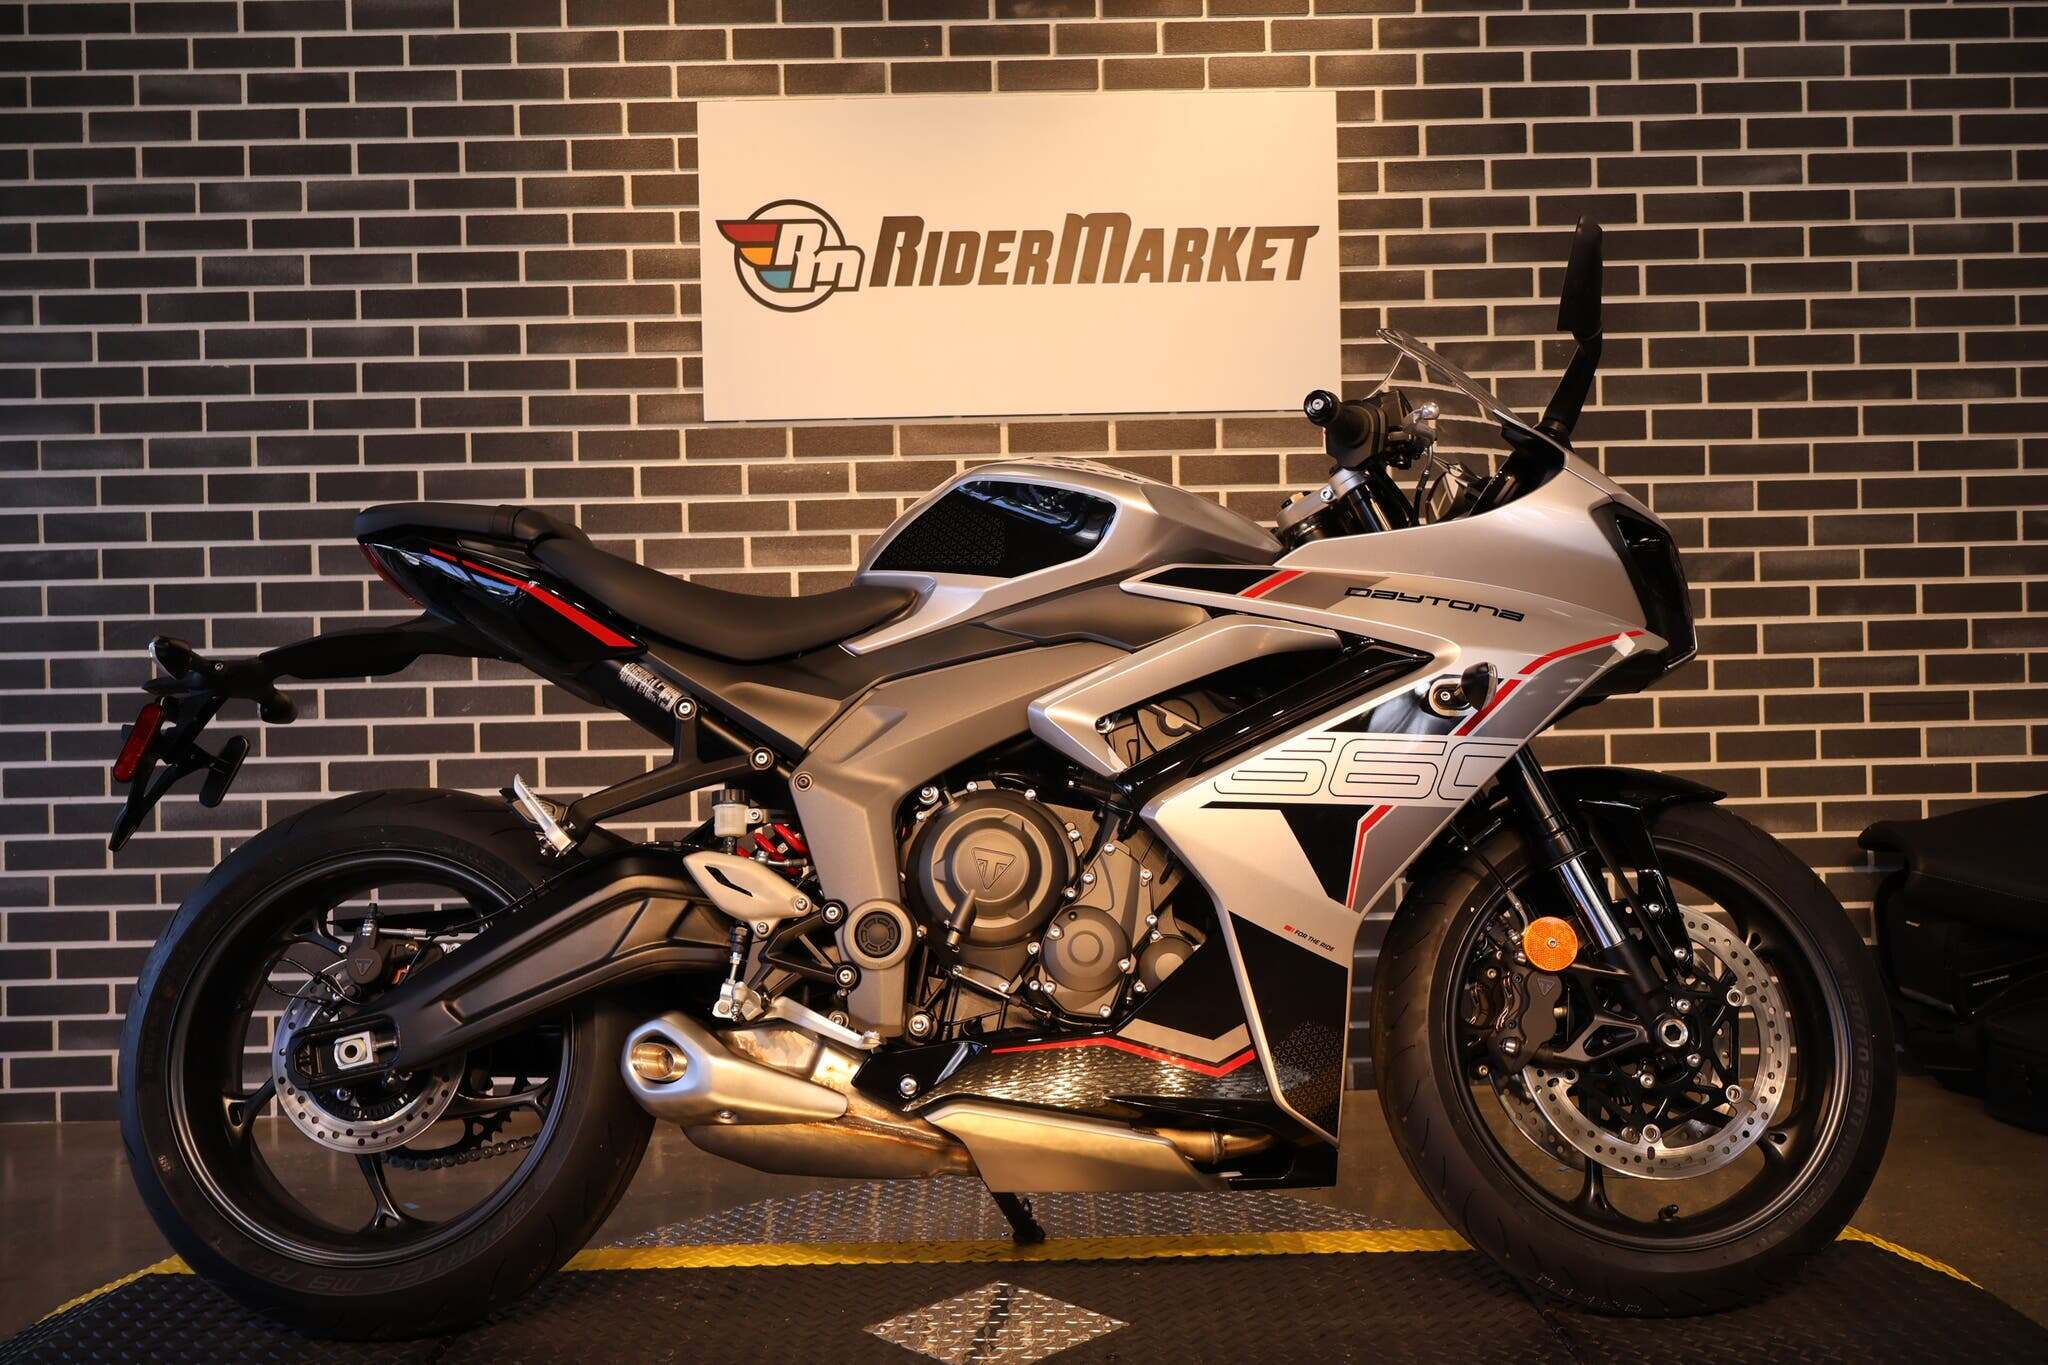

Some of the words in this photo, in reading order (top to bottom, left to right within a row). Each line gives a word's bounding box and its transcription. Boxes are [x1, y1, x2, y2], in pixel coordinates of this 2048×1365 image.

[1294, 929, 1308, 939] FOR
[1307, 936, 1321, 946] THE
[1319, 942, 1336, 952] RIDE
